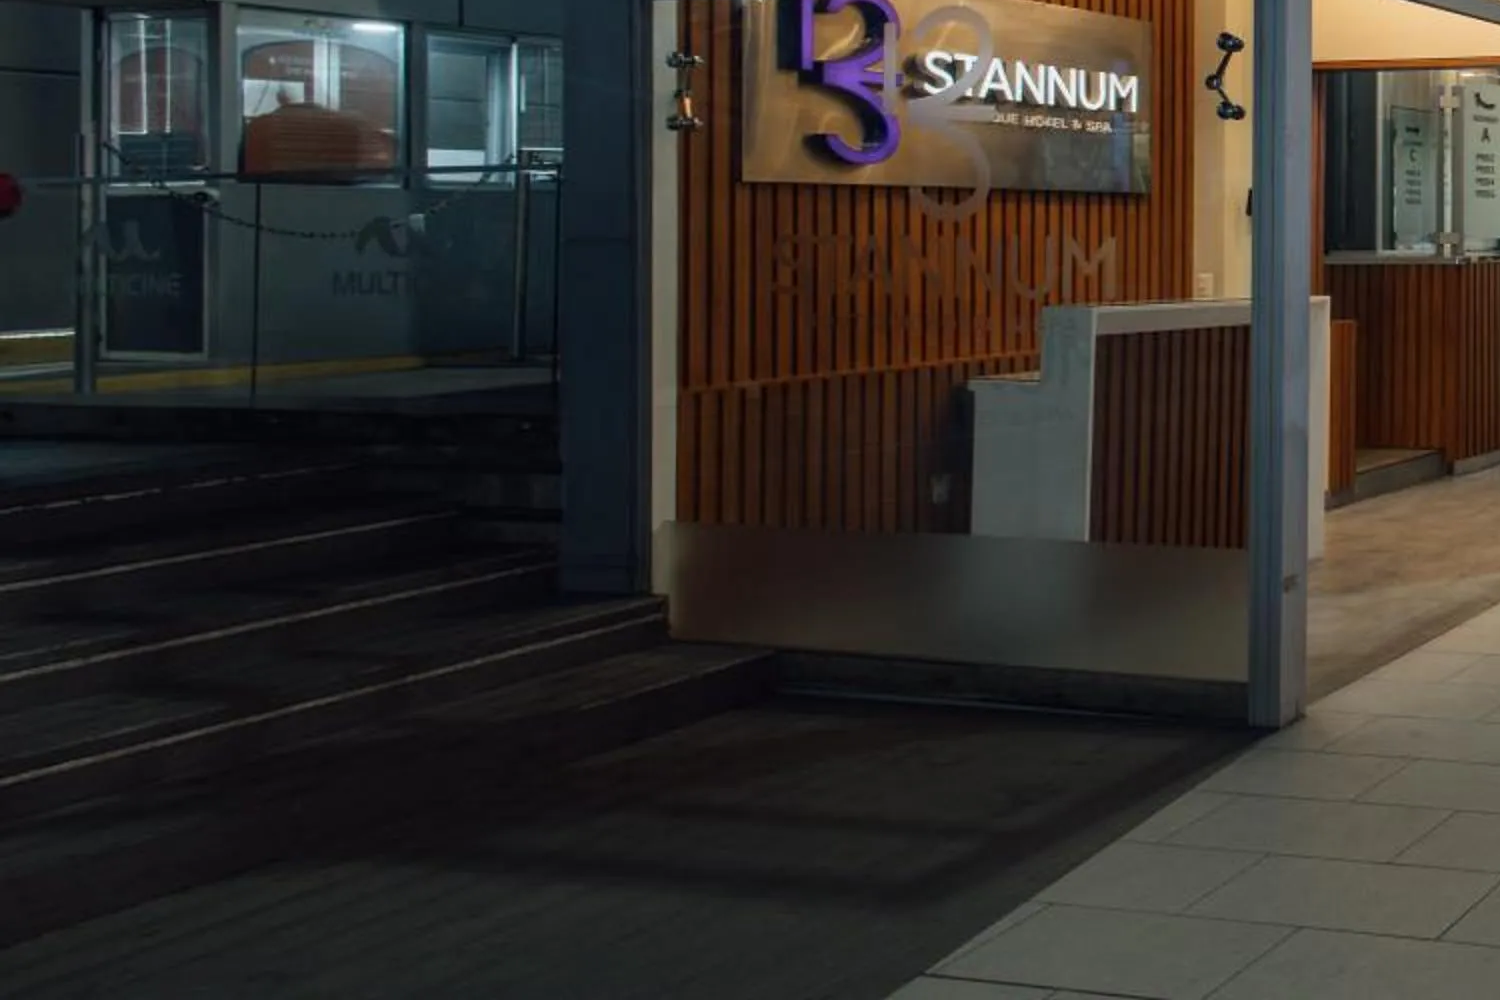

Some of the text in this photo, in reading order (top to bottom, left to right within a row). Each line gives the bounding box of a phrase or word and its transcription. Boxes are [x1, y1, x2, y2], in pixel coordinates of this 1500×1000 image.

[923, 50, 1139, 113] STANNUM
[1086, 121, 1113, 134] SPA
[1480, 127, 1491, 143] A
